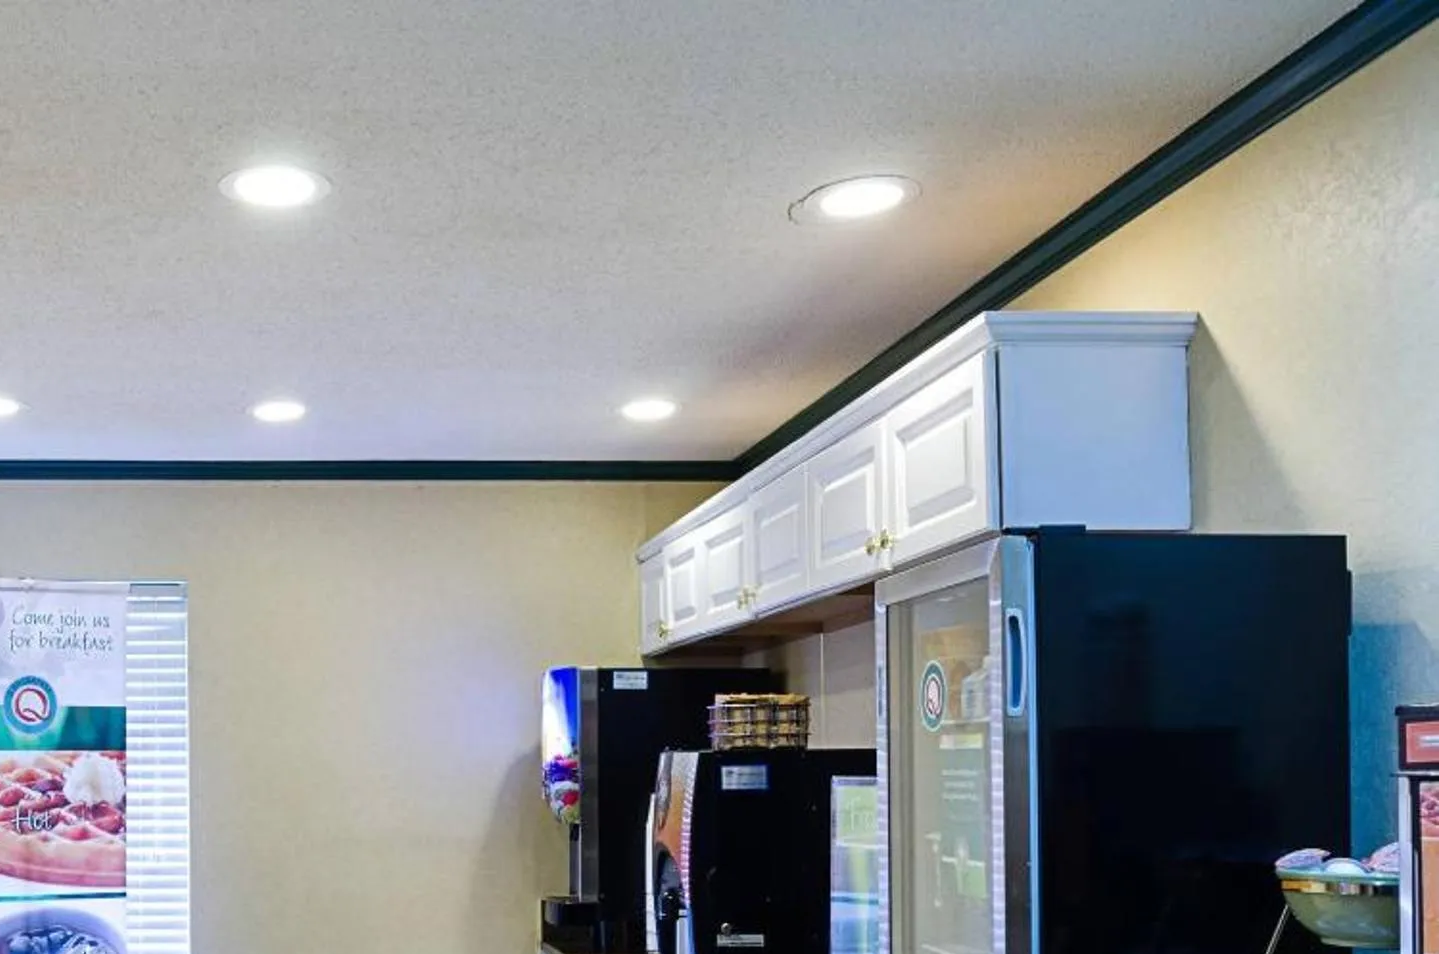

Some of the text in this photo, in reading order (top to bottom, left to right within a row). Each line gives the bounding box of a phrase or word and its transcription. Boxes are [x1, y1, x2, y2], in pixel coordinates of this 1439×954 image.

[12, 604, 110, 634] Come join us
[8, 628, 113, 655] for breakfast
[14, 687, 51, 723] Q
[11, 803, 53, 834] Hot
